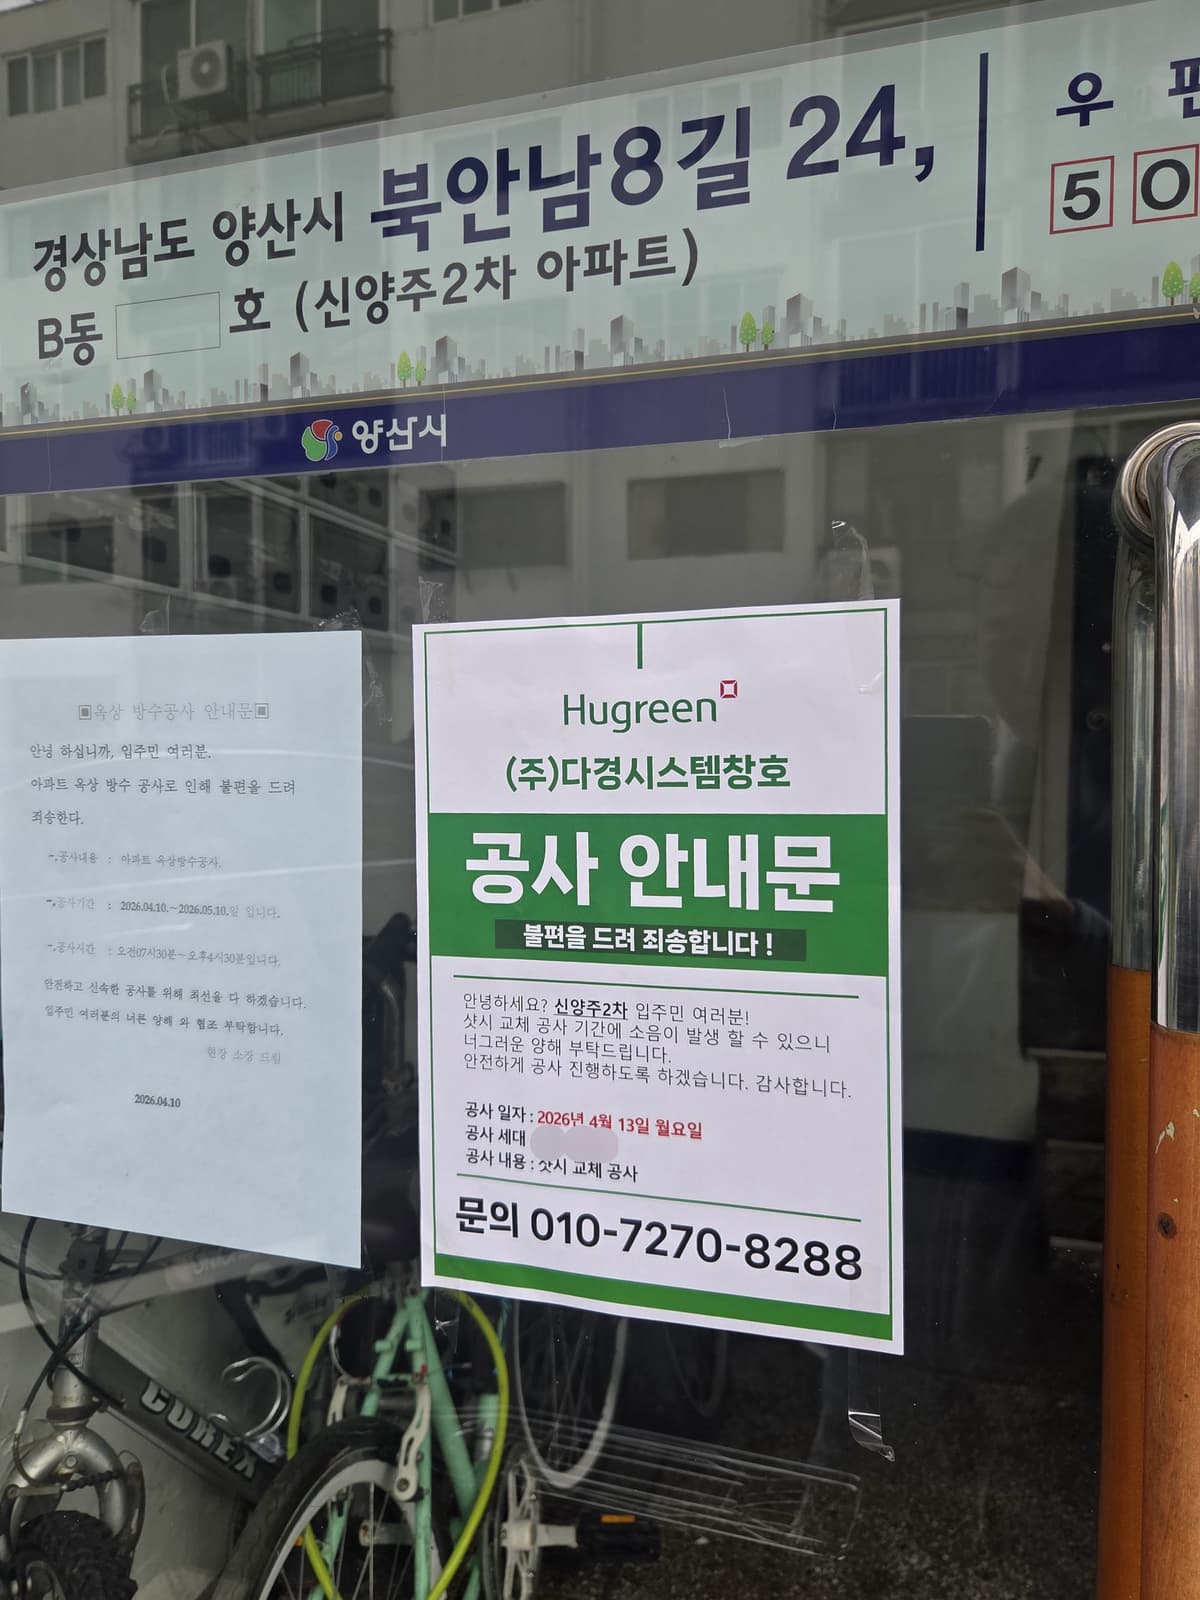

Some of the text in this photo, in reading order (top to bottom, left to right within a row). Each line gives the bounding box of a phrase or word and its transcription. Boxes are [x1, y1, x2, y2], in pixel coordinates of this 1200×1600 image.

[1056, 72, 1114, 127] 우
[33, 84, 934, 292] 경상남도 양산시 북안남8길 24,
[1062, 170, 1101, 220] 5
[38, 228, 699, 366] B동 호 (신양주2차 아파트)
[352, 414, 447, 455] 양산시
[563, 693, 717, 733] Hugreen
[30, 743, 212, 760] 안녕 하십니까, 입주민 여러분.
[31, 776, 296, 796] 아파트 옥상 방수 공사로 인해 불편을 드려
[505, 754, 792, 793] (주)다경시스템창호
[31, 810, 84, 826] 죄송한다.
[121, 852, 152, 866] 아파트
[465, 831, 841, 913] 공사 안내문
[523, 922, 588, 951] 불편을
[592, 926, 636, 953] 드려
[641, 929, 759, 957] 죄송합니다
[89, 981, 120, 997] 신속한
[125, 983, 157, 999] 공사를
[162, 986, 184, 1001] 위해
[229, 991, 240, 1005] 다
[246, 992, 307, 1010] 하겠습니다.
[463, 992, 751, 1027] 안녕하세요? 신양주2차 입주민 여러분!
[152, 1015, 174, 1028] 양해
[179, 1017, 190, 1029] 와
[224, 1019, 285, 1037] 부탁합니다.
[463, 1012, 831, 1054] 샷시 교체 공사 기간에 소음이 발생 할 수 있으니
[463, 1033, 672, 1064] 너그러운 양해 부탁드립니다.
[463, 1053, 853, 1100] 안전하게 공사 진행하도록 하겠습니다. 감사합니다.
[134, 1093, 182, 1110] 2026.04.10
[465, 1102, 493, 1120] 공사
[497, 1104, 526, 1123] 일자
[537, 1110, 584, 1127] 2026년
[589, 1114, 613, 1130] 4월
[618, 1117, 650, 1135] 13일
[655, 1119, 703, 1140] 월요일
[465, 1125, 526, 1147] 공사 세대
[466, 1148, 494, 1167] 공사
[499, 1151, 526, 1169] 내용
[572, 1161, 602, 1179] 교체
[607, 1163, 639, 1183] 공사
[456, 1196, 863, 1281] 문의 010-7270-8288
